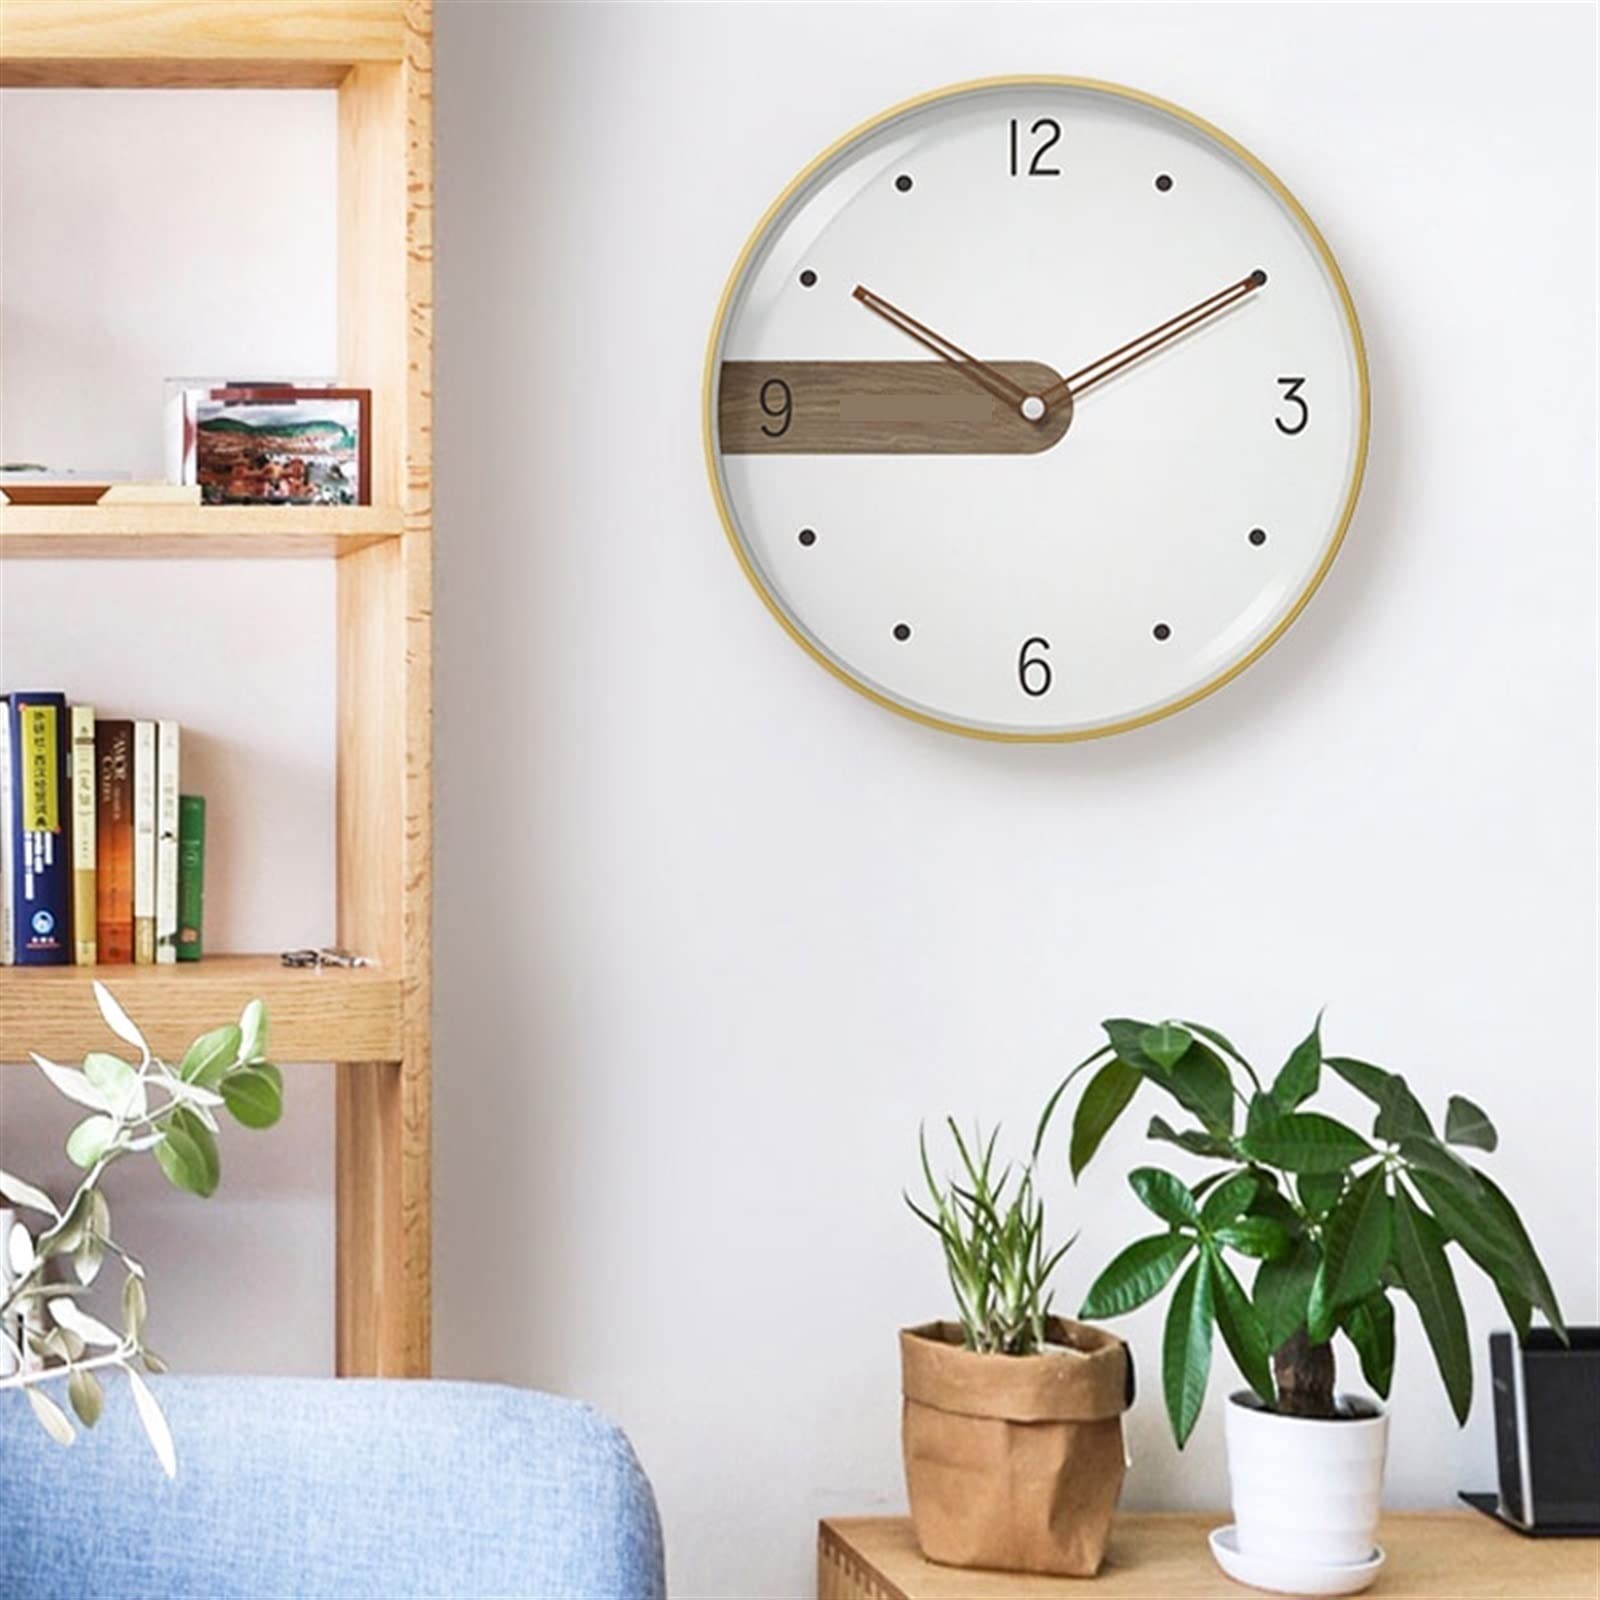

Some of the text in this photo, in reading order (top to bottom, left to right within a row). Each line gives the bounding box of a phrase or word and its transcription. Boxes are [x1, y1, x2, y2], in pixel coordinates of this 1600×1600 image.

[1010, 118, 1062, 177] 12
[759, 378, 793, 438] 9
[1275, 377, 1309, 435] 3
[1018, 637, 1052, 697] 6
